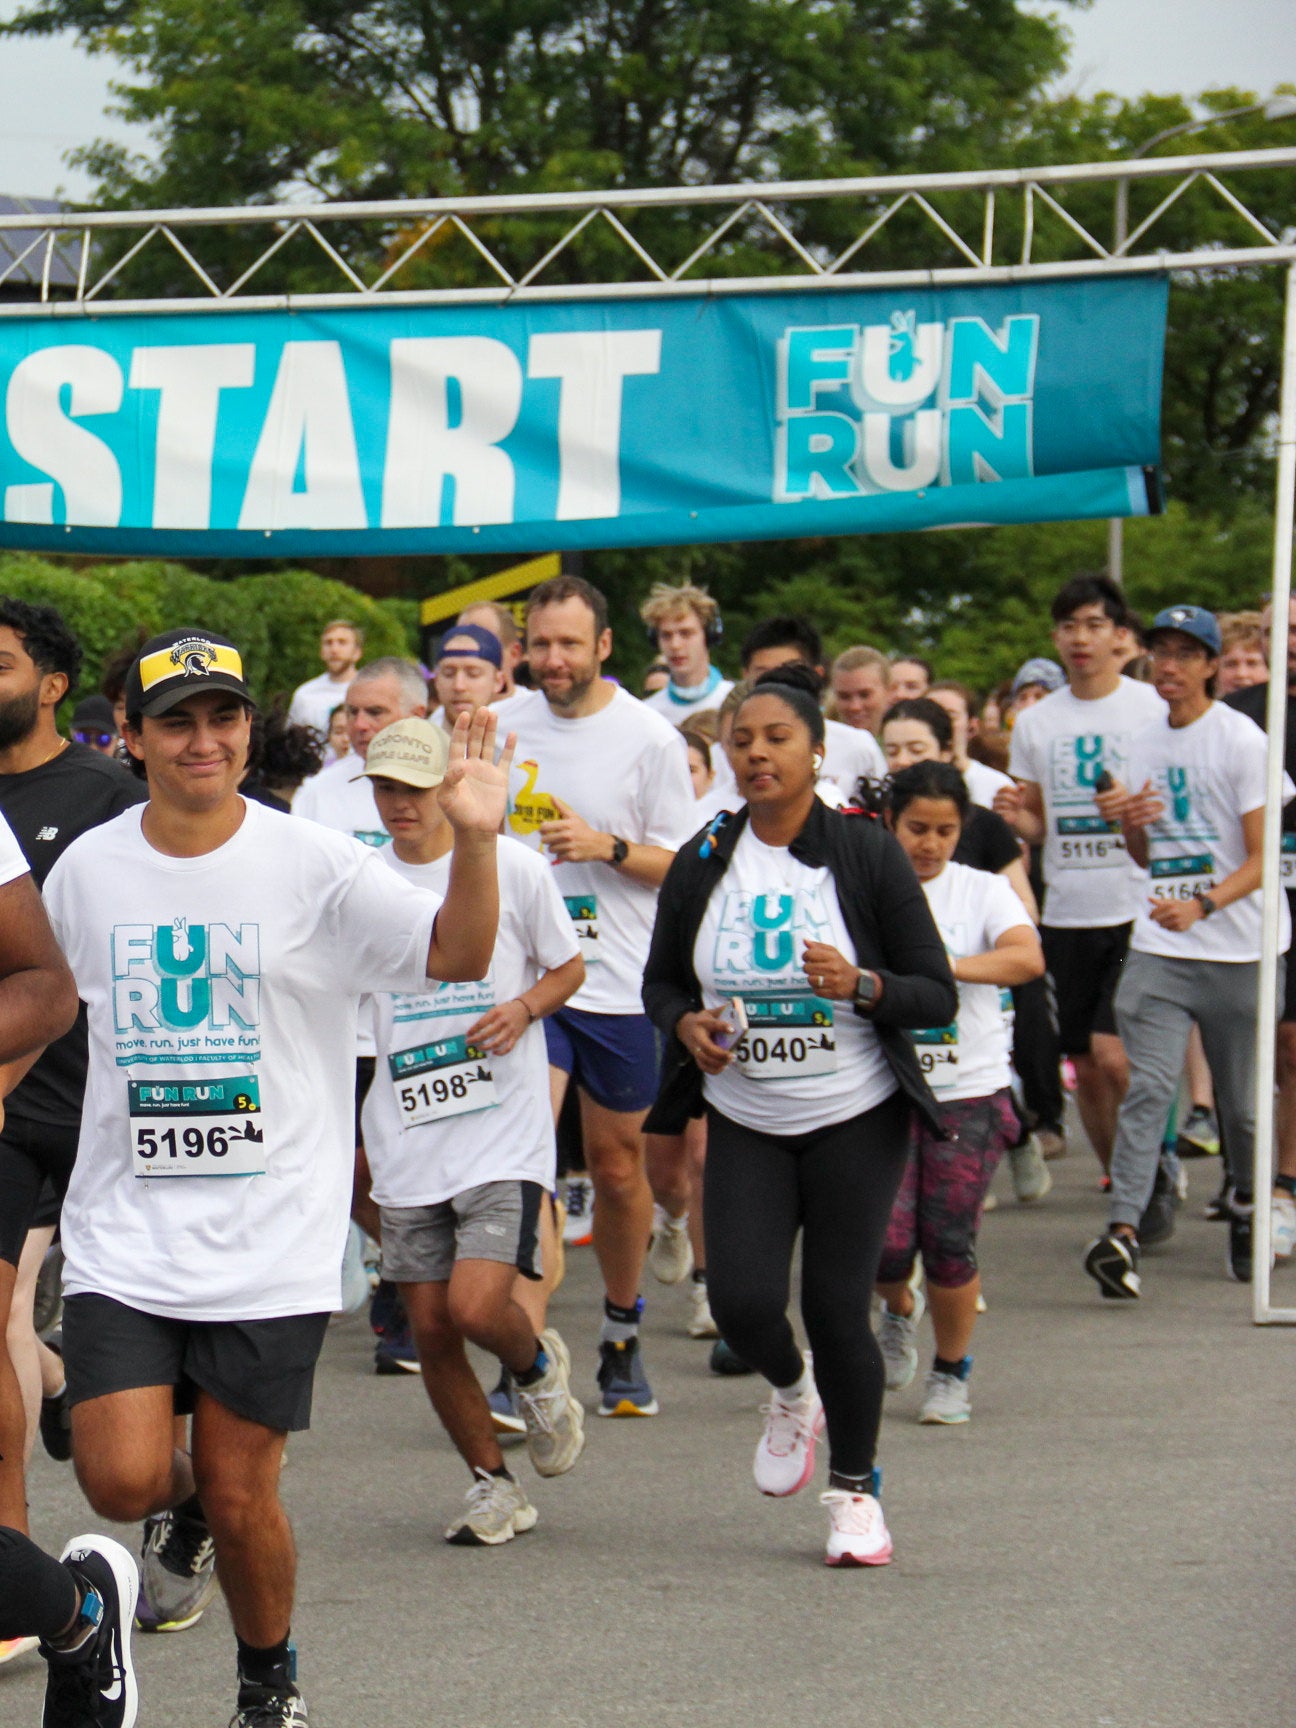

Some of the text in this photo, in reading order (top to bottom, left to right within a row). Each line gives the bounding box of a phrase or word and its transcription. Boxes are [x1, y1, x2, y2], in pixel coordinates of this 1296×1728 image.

[776, 311, 1040, 421] FUN
[4, 328, 662, 532] START
[772, 400, 1036, 504] RUN
[1062, 841, 1107, 858] 5116
[720, 888, 831, 932] FUN
[110, 919, 261, 979] FUN
[111, 976, 261, 1034] RUN
[177, 1037, 202, 1051] just
[204, 1035, 236, 1047] have
[736, 1036, 808, 1063] 5040
[139, 1084, 225, 1102] FUN RUN
[237, 1096, 247, 1109] 5
[400, 1074, 468, 1112] 5198
[137, 1126, 229, 1159] 5196
